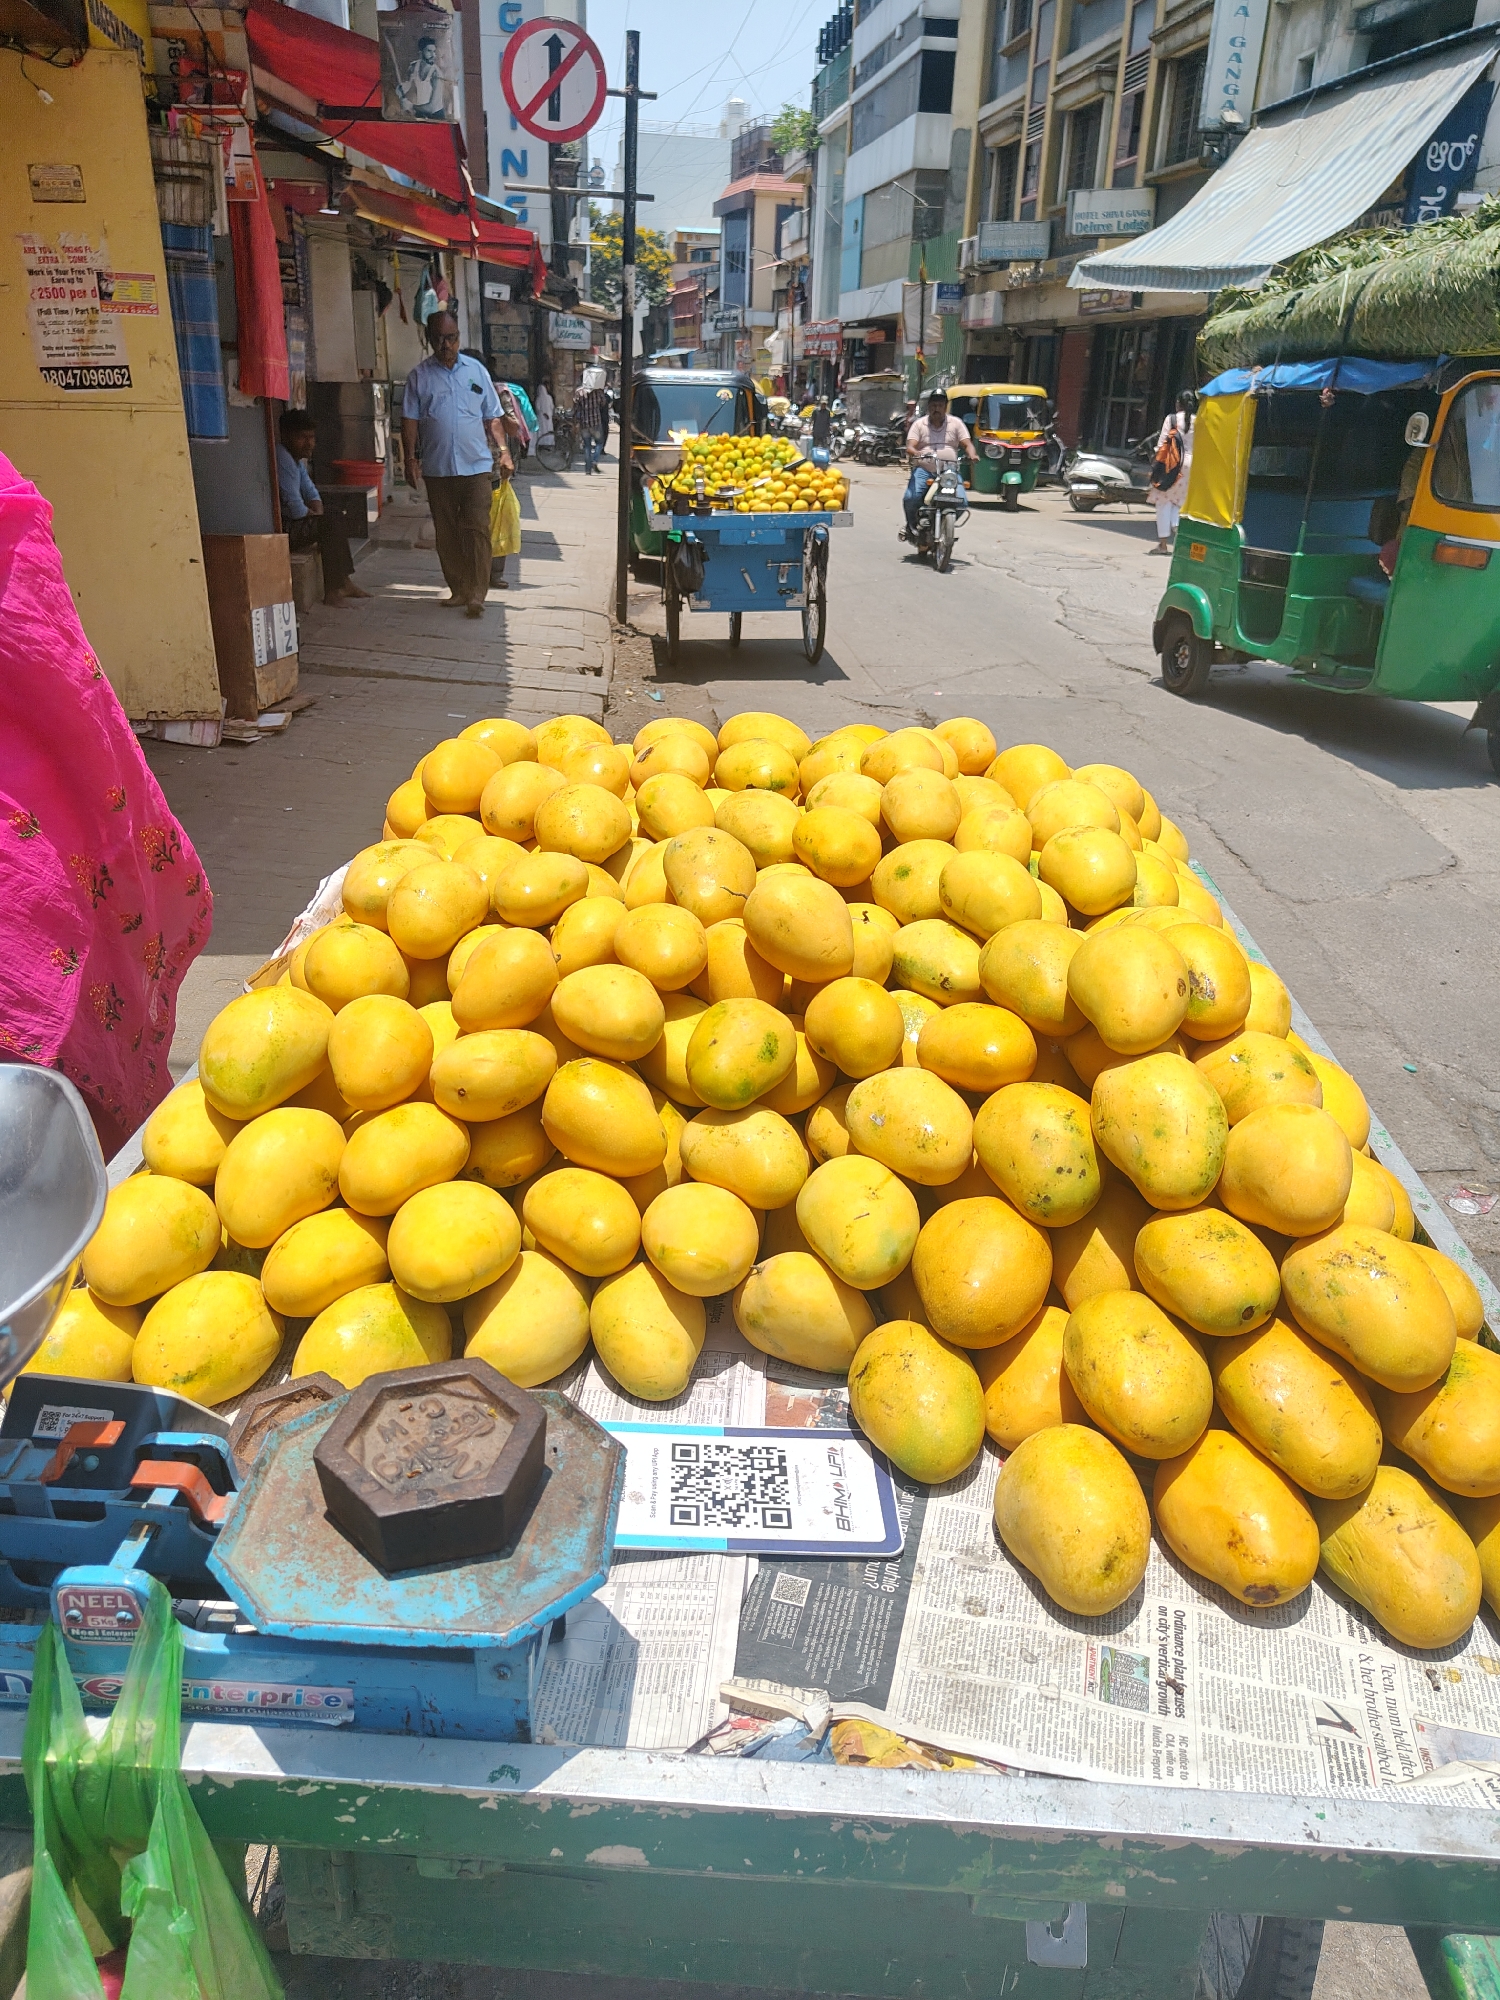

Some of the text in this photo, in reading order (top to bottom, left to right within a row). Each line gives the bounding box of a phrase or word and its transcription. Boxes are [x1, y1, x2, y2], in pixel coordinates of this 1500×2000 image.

[1221, 36, 1247, 111] GANGA
[1075, 212, 1098, 220] HOTEL
[1075, 219, 1150, 233] Deluxe Lodge
[27, 268, 44, 276] Work
[71, 268, 86, 276] Free
[37, 256, 60, 265] EXTRA
[69, 289, 87, 302] per
[42, 367, 131, 388] 08047096062
[650, 1491, 658, 1500] Pay
[651, 1477, 659, 1490] using
[827, 1451, 851, 1532] BHIM UPI
[902, 1485, 919, 1502] Can
[649, 1504, 657, 1518] Scan
[881, 1562, 901, 1593] while
[68, 1594, 130, 1609] NEEL
[1158, 1605, 1168, 1617] on
[71, 1628, 140, 1637] Neel Enterpri
[1155, 1618, 1170, 1642] city's
[1087, 1646, 1096, 1693] APARTMENT ACT
[1172, 1610, 1187, 1718] Ordinance plan fcuses
[1358, 1653, 1374, 1664] &
[1360, 1666, 1376, 1687] her
[1381, 1663, 1397, 1694] Teen,
[181, 1682, 344, 1709] Enterprise
[1155, 1680, 1171, 1716] growth
[1363, 1688, 1383, 1732] brother
[1385, 1696, 1401, 1727] mom
[1391, 1728, 1408, 1751] held
[1151, 1725, 1162, 1780] Muda B-report
[1164, 1733, 1176, 1777] CM, wife on
[1178, 1735, 1189, 1781] HC notice to
[1371, 1732, 1397, 1777] stabbed
[1350, 1755, 1361, 1784] relationship
[1396, 1752, 1417, 1779] after
